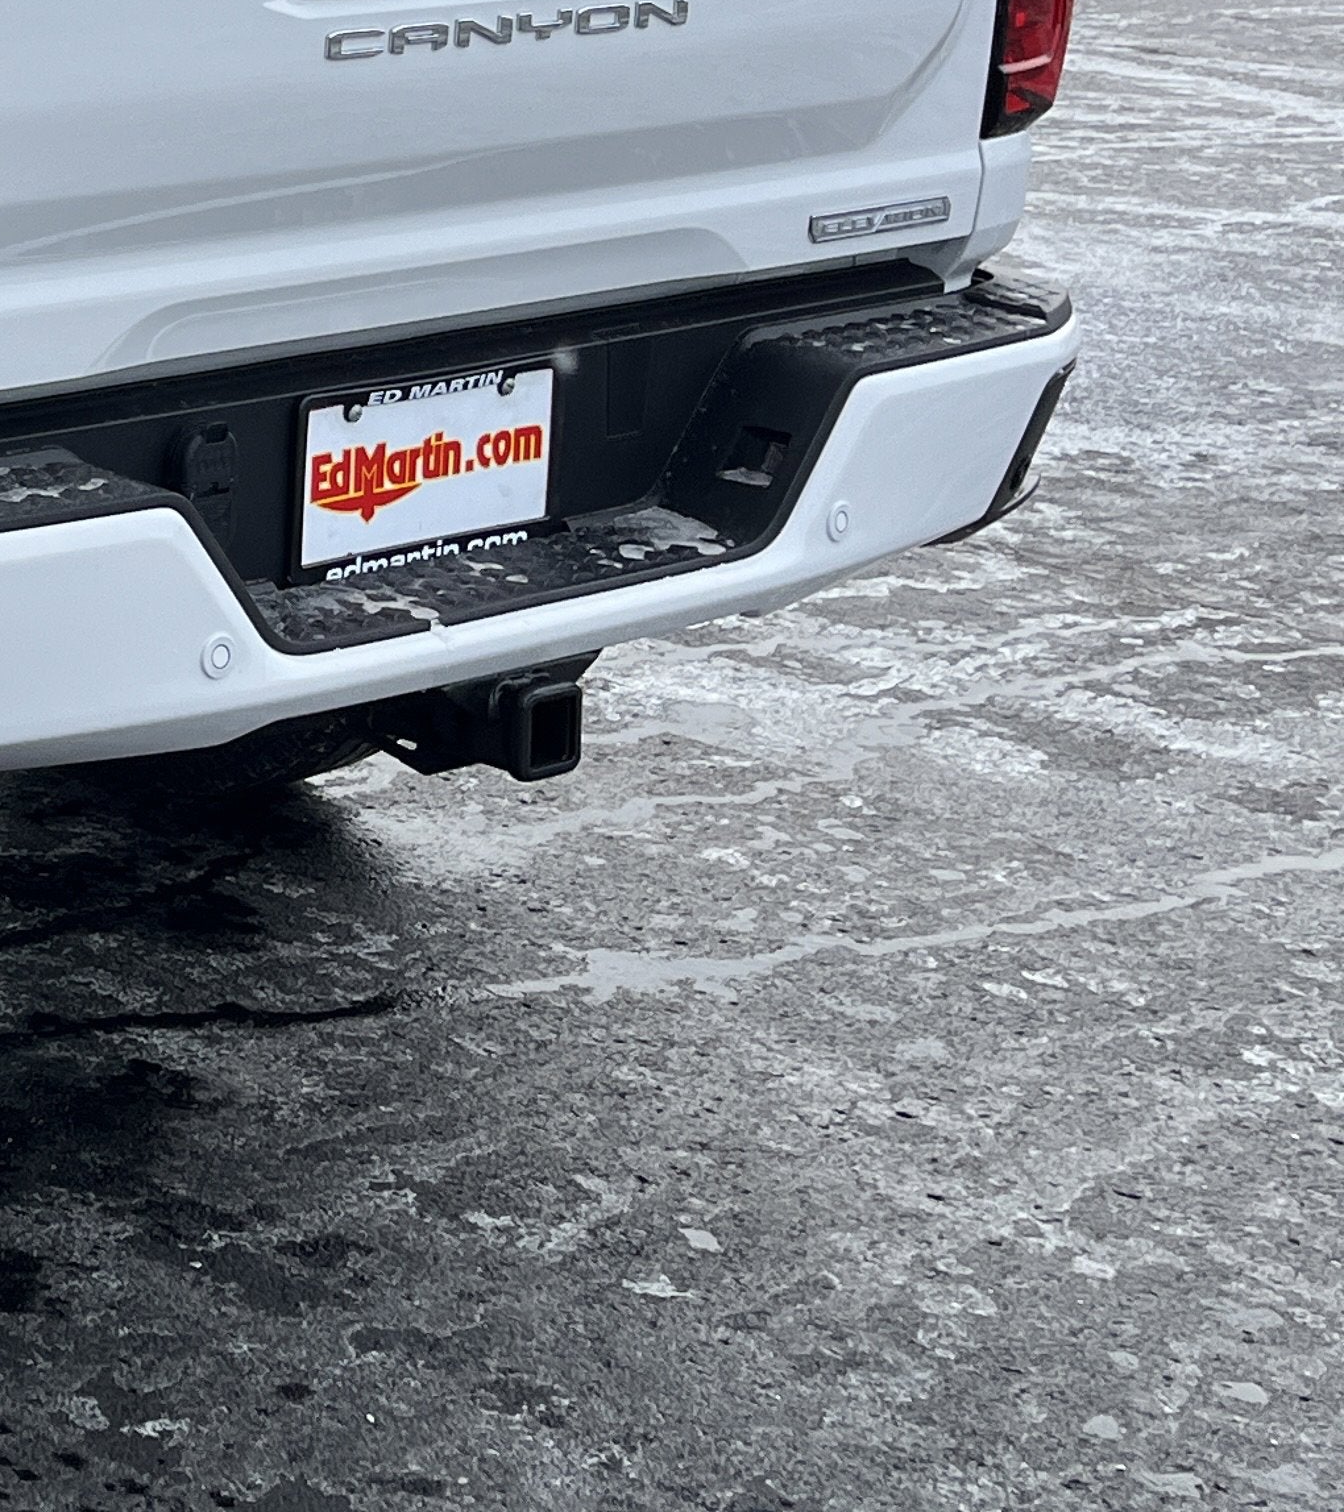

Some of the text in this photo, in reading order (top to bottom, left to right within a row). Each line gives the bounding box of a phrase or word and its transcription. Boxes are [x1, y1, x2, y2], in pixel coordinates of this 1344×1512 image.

[367, 370, 504, 406] ED MARTIN
[310, 425, 543, 506] EdMartin.com
[325, 530, 528, 582] edmartincom
